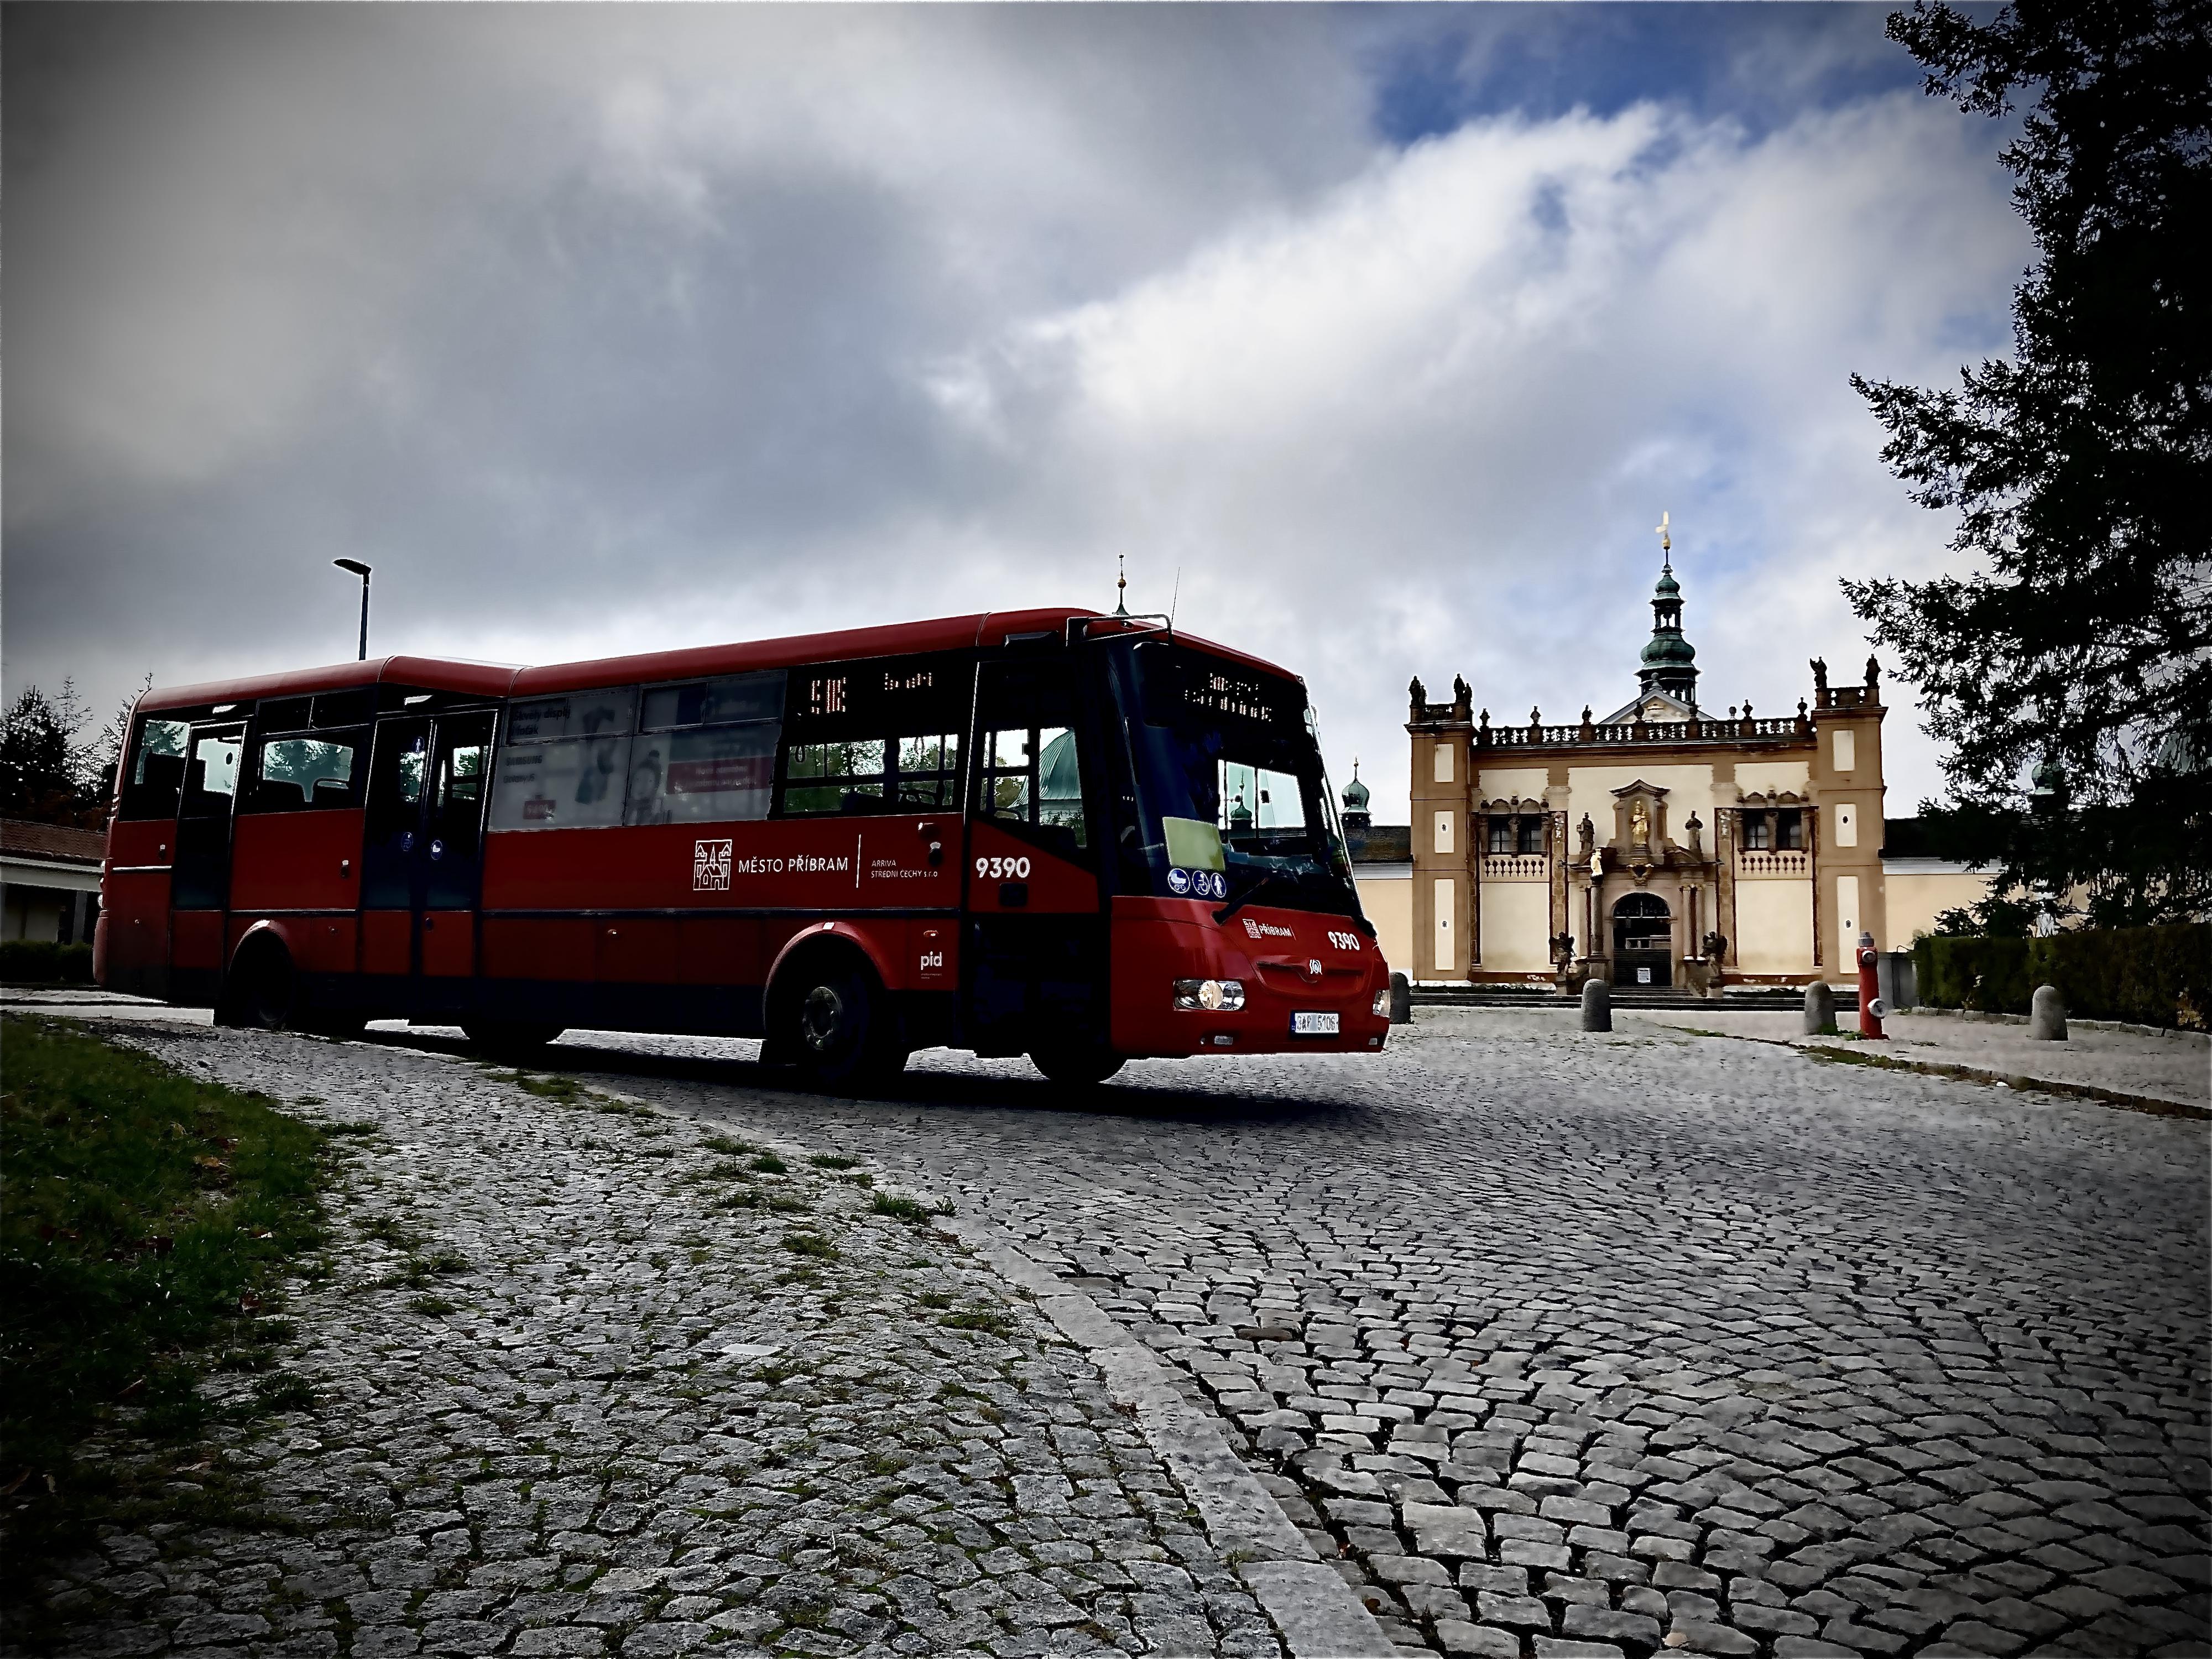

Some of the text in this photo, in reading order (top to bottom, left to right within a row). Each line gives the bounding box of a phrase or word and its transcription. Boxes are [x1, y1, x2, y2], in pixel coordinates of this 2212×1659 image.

[505, 755, 542, 766] SAMSUNG
[738, 854, 848, 873] MĚSTO PŘÍBRAM
[871, 859, 896, 868] ARRIVA
[976, 857, 1030, 878] 9390
[900, 869, 922, 878] ČECHY
[1258, 923, 1292, 937] PŘÍBRAM
[1328, 931, 1360, 951] 9390
[921, 951, 942, 971] pid
